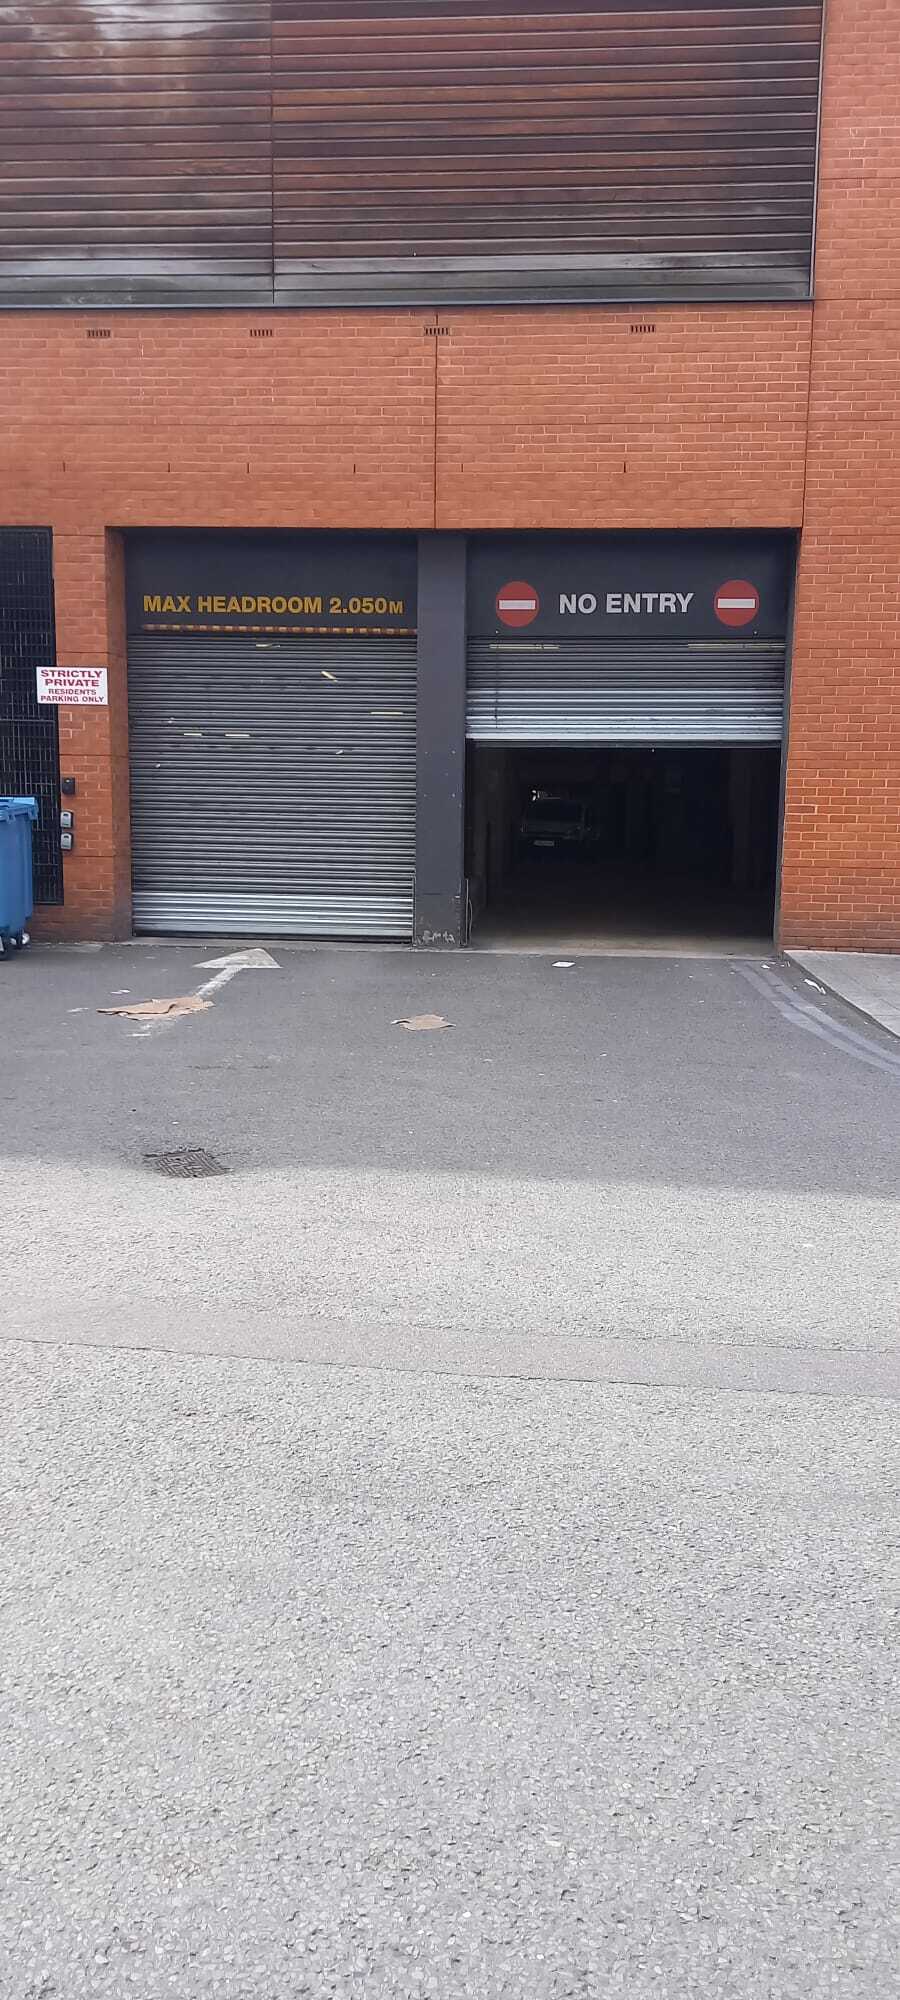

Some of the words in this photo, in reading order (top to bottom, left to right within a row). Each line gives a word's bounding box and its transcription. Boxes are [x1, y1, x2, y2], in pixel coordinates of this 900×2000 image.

[143, 595, 191, 613] MAX
[197, 595, 322, 614] HEADROOM
[559, 593, 597, 614] NO
[606, 592, 694, 613] ENTRY
[41, 669, 103, 678] STRICTLY
[45, 678, 100, 687] PRIVATE
[48, 688, 97, 696] RESIDENTS
[40, 695, 79, 703] PARKING
